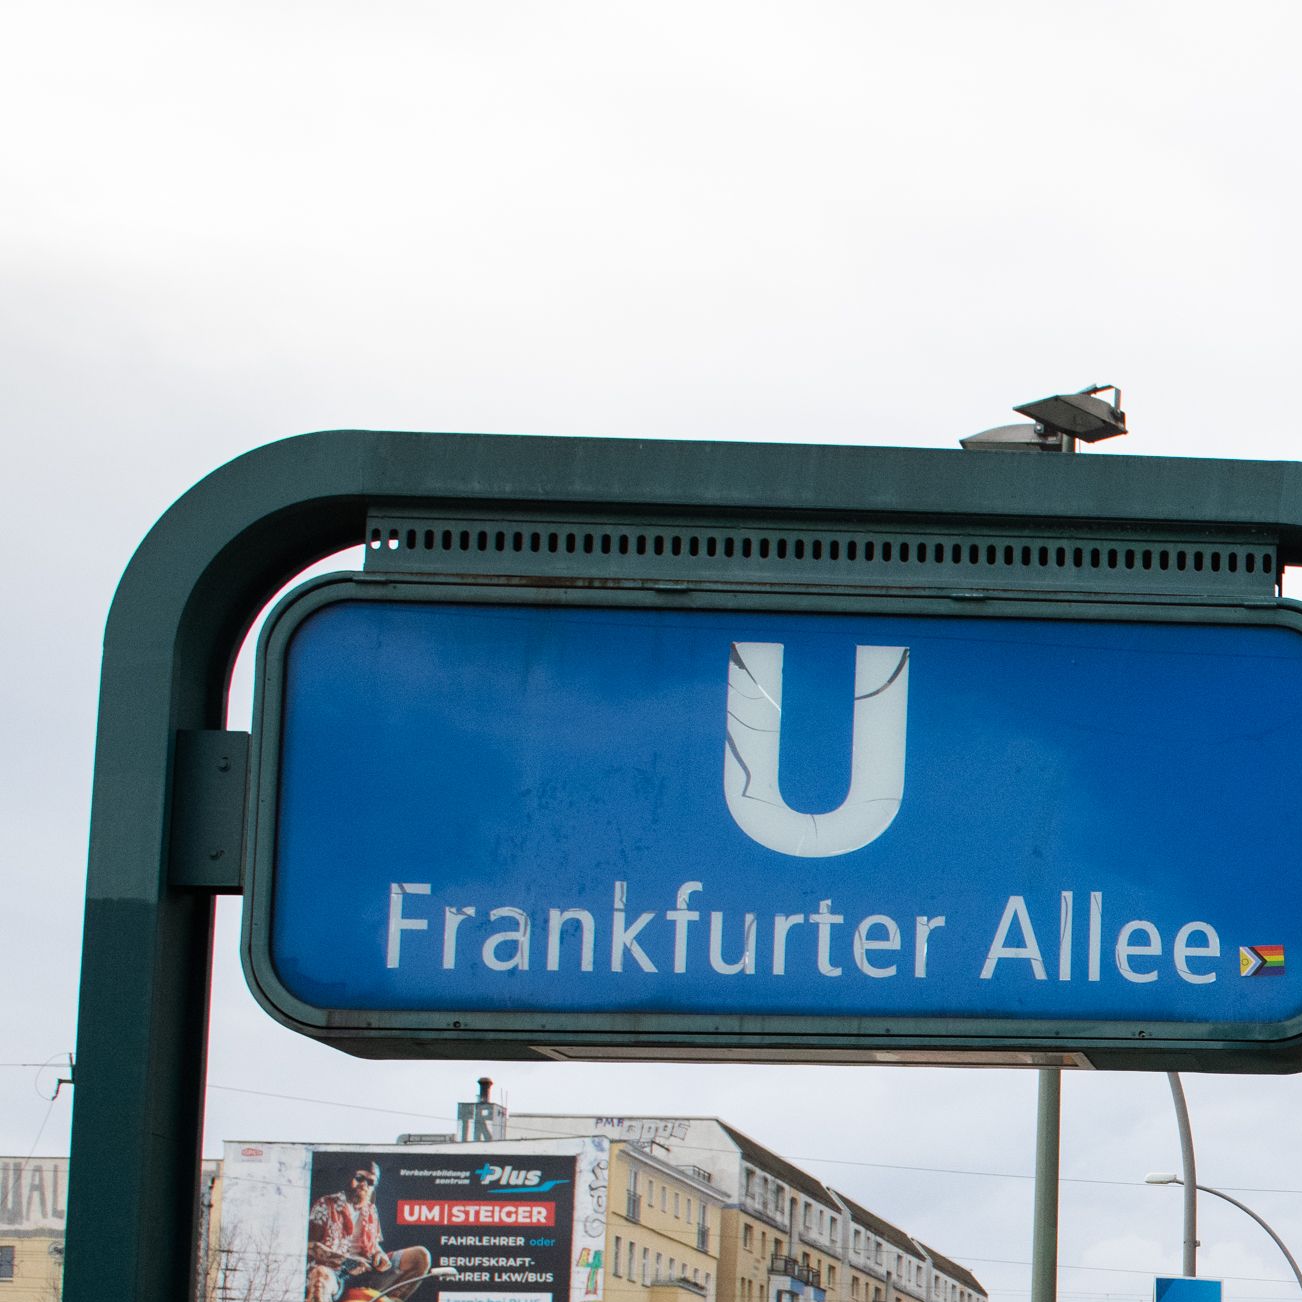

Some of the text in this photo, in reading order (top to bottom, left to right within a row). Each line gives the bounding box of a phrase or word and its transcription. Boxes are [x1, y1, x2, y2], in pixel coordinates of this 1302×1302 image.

[723, 641, 911, 858] U
[386, 881, 1222, 985] Frankfurter Allee
[440, 1236, 556, 1247] FAHRLEHRER oder
[439, 1257, 536, 1268] BERUFSKRAFT-
[494, 1272, 554, 1283] LKW/BUS
